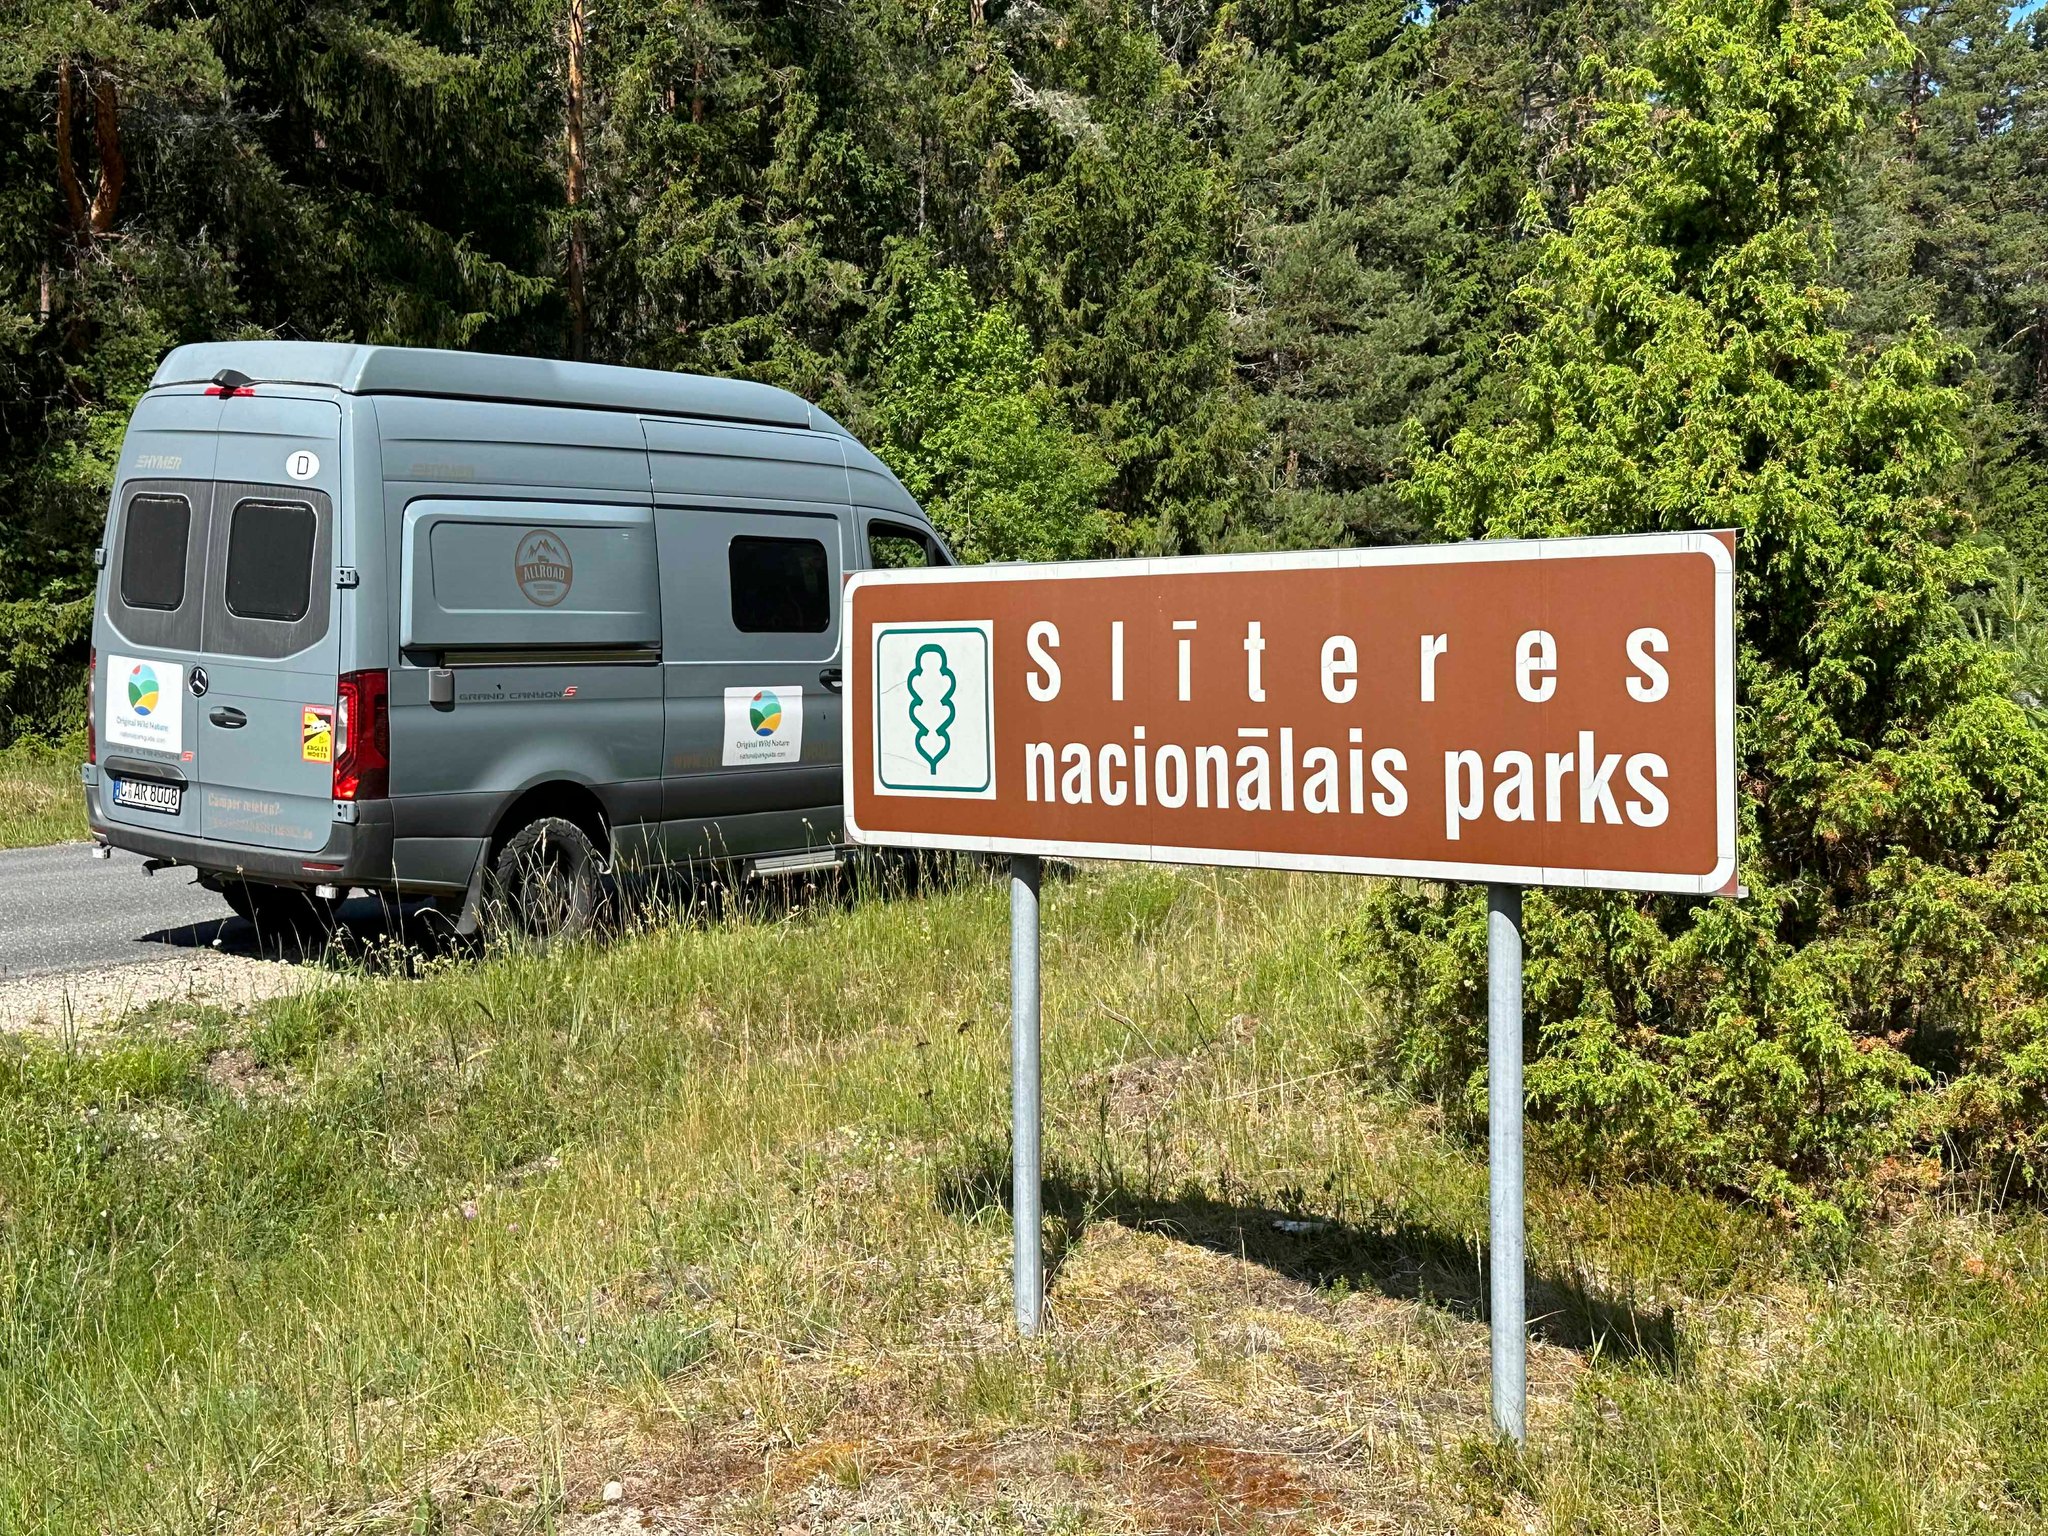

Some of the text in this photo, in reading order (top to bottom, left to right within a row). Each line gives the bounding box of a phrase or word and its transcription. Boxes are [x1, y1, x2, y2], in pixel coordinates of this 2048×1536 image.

[135, 455, 182, 470] HYMER
[296, 456, 310, 475] D
[523, 563, 566, 581] ALLROAD
[1025, 619, 1670, 703] Slīteres
[459, 692, 505, 700] GRAND
[509, 690, 562, 700] CANYON
[1024, 725, 1670, 841] nacionālais parks
[133, 782, 148, 801] AR
[150, 785, 178, 806] 8008
